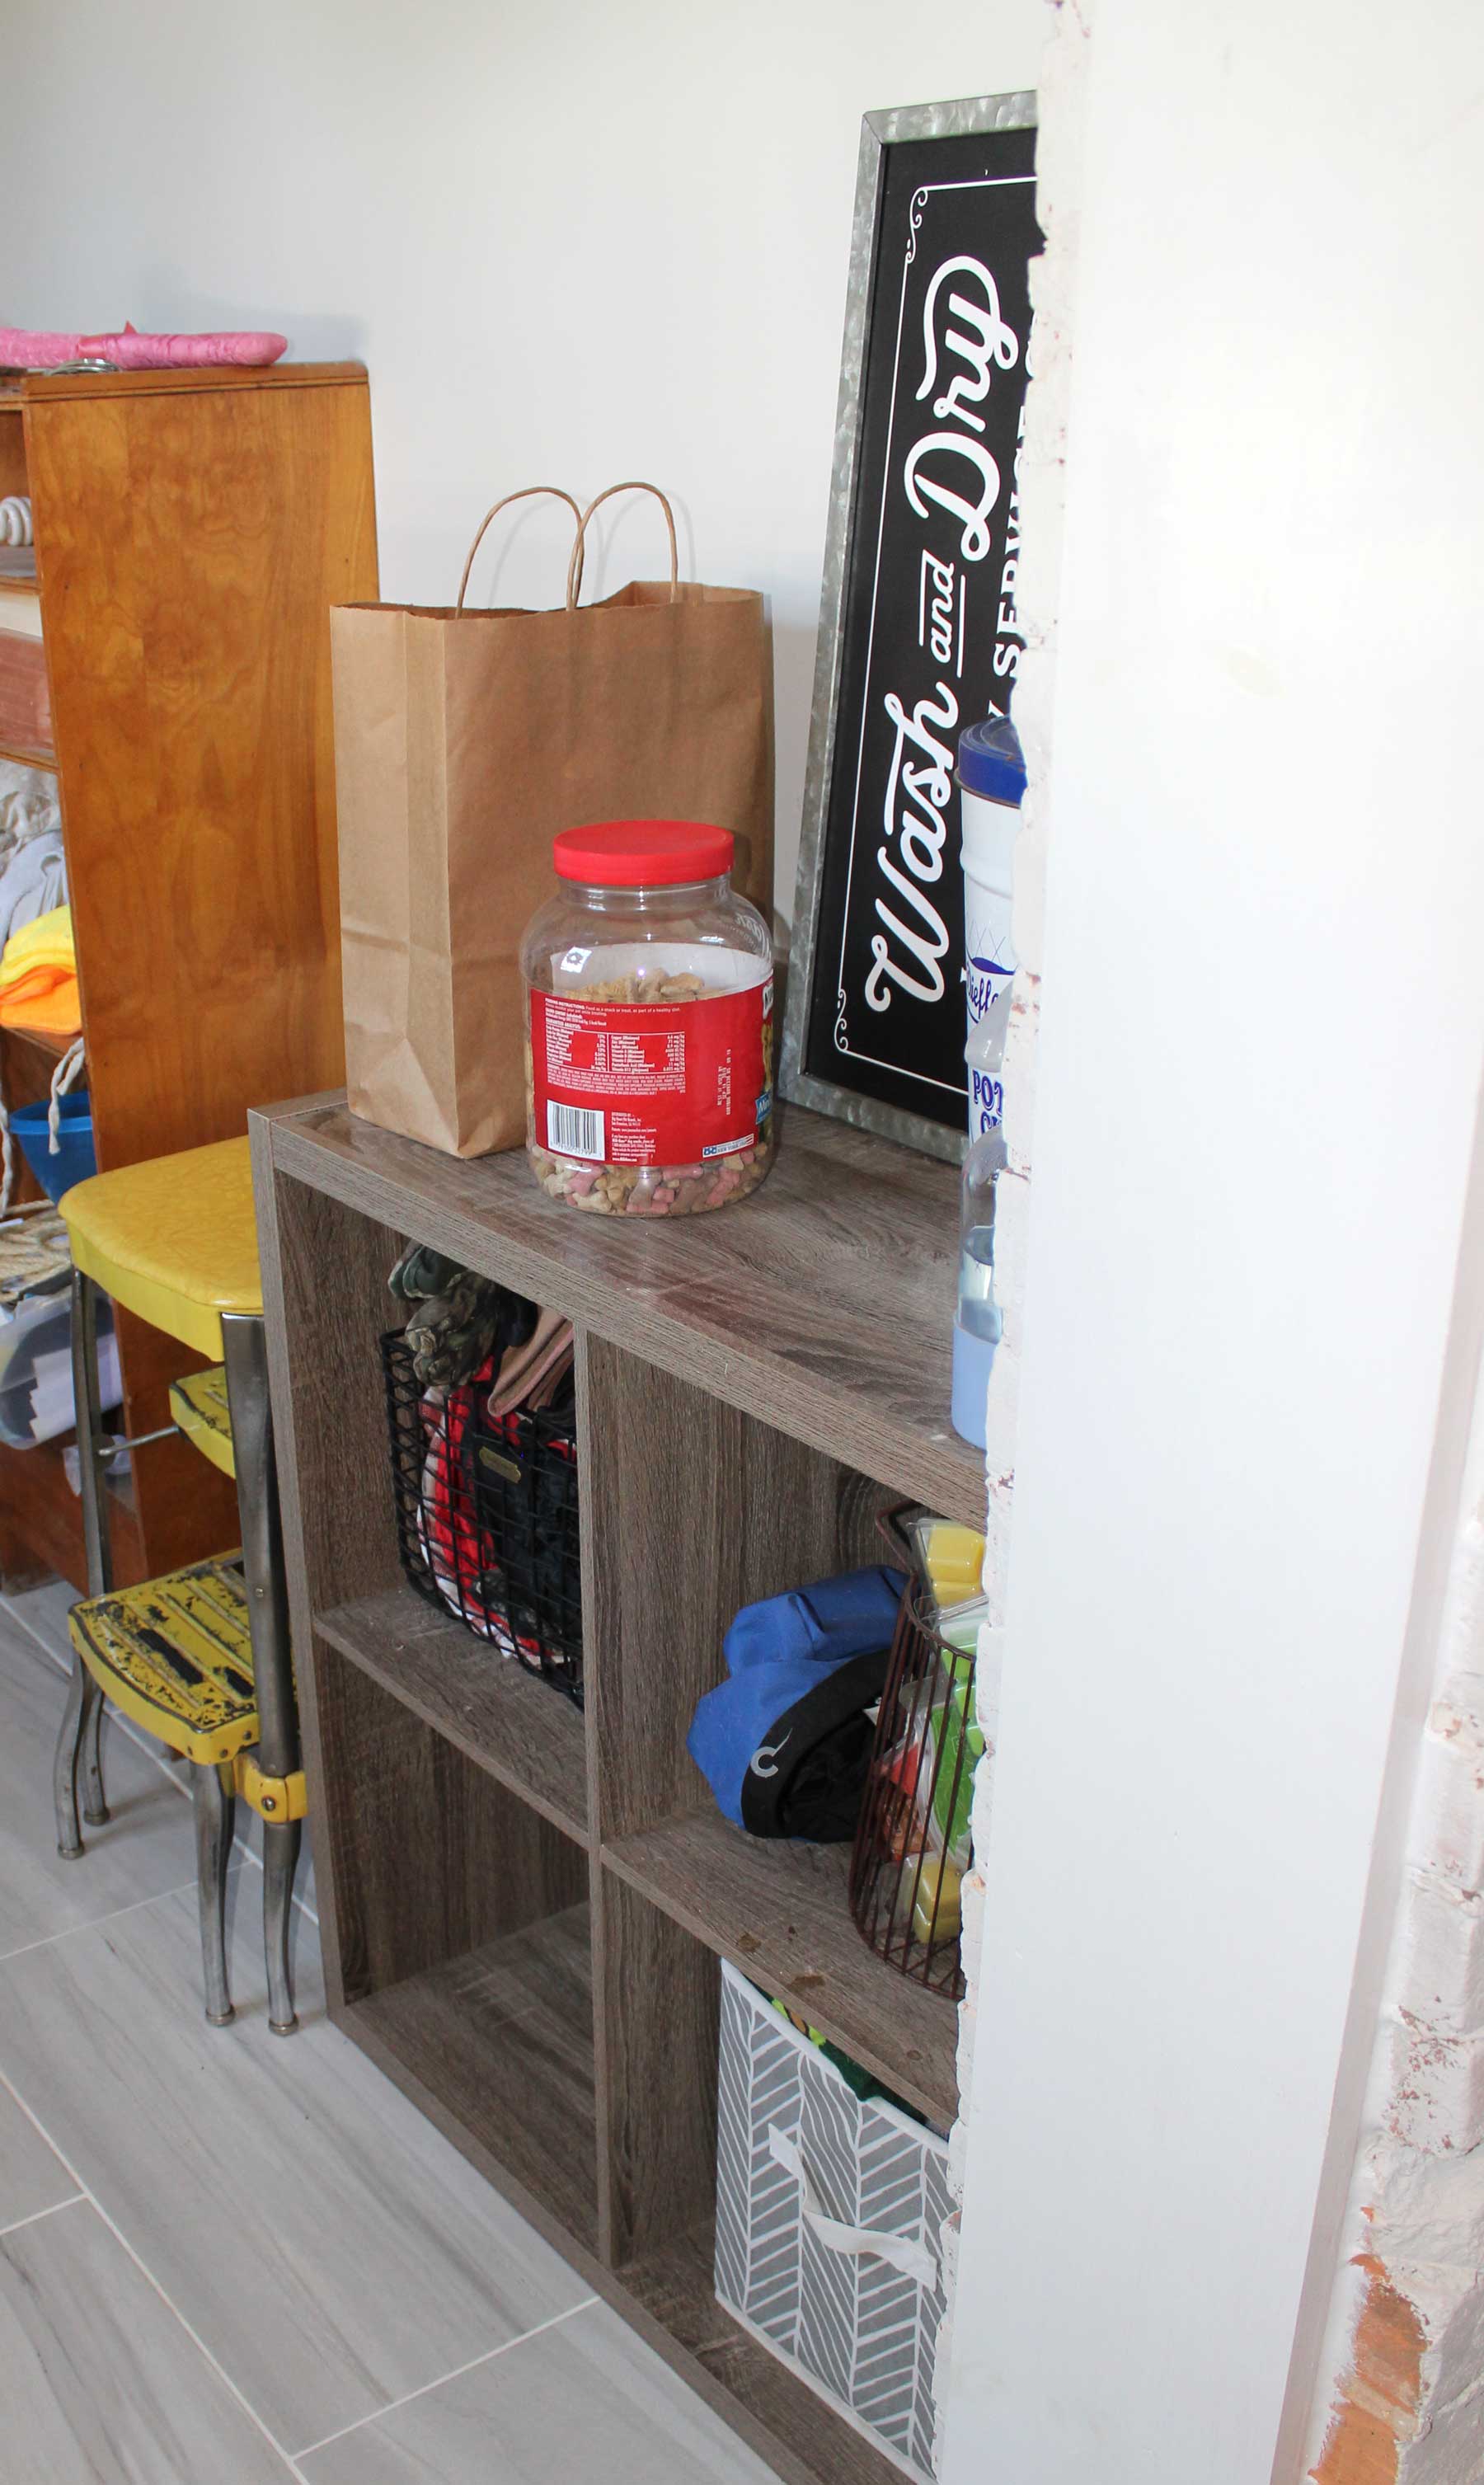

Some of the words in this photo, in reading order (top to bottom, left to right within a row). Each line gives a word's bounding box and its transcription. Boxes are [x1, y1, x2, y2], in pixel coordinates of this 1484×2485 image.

[904, 256, 1018, 561] Dry
[921, 549, 954, 663] and
[865, 682, 958, 1012] Wash
